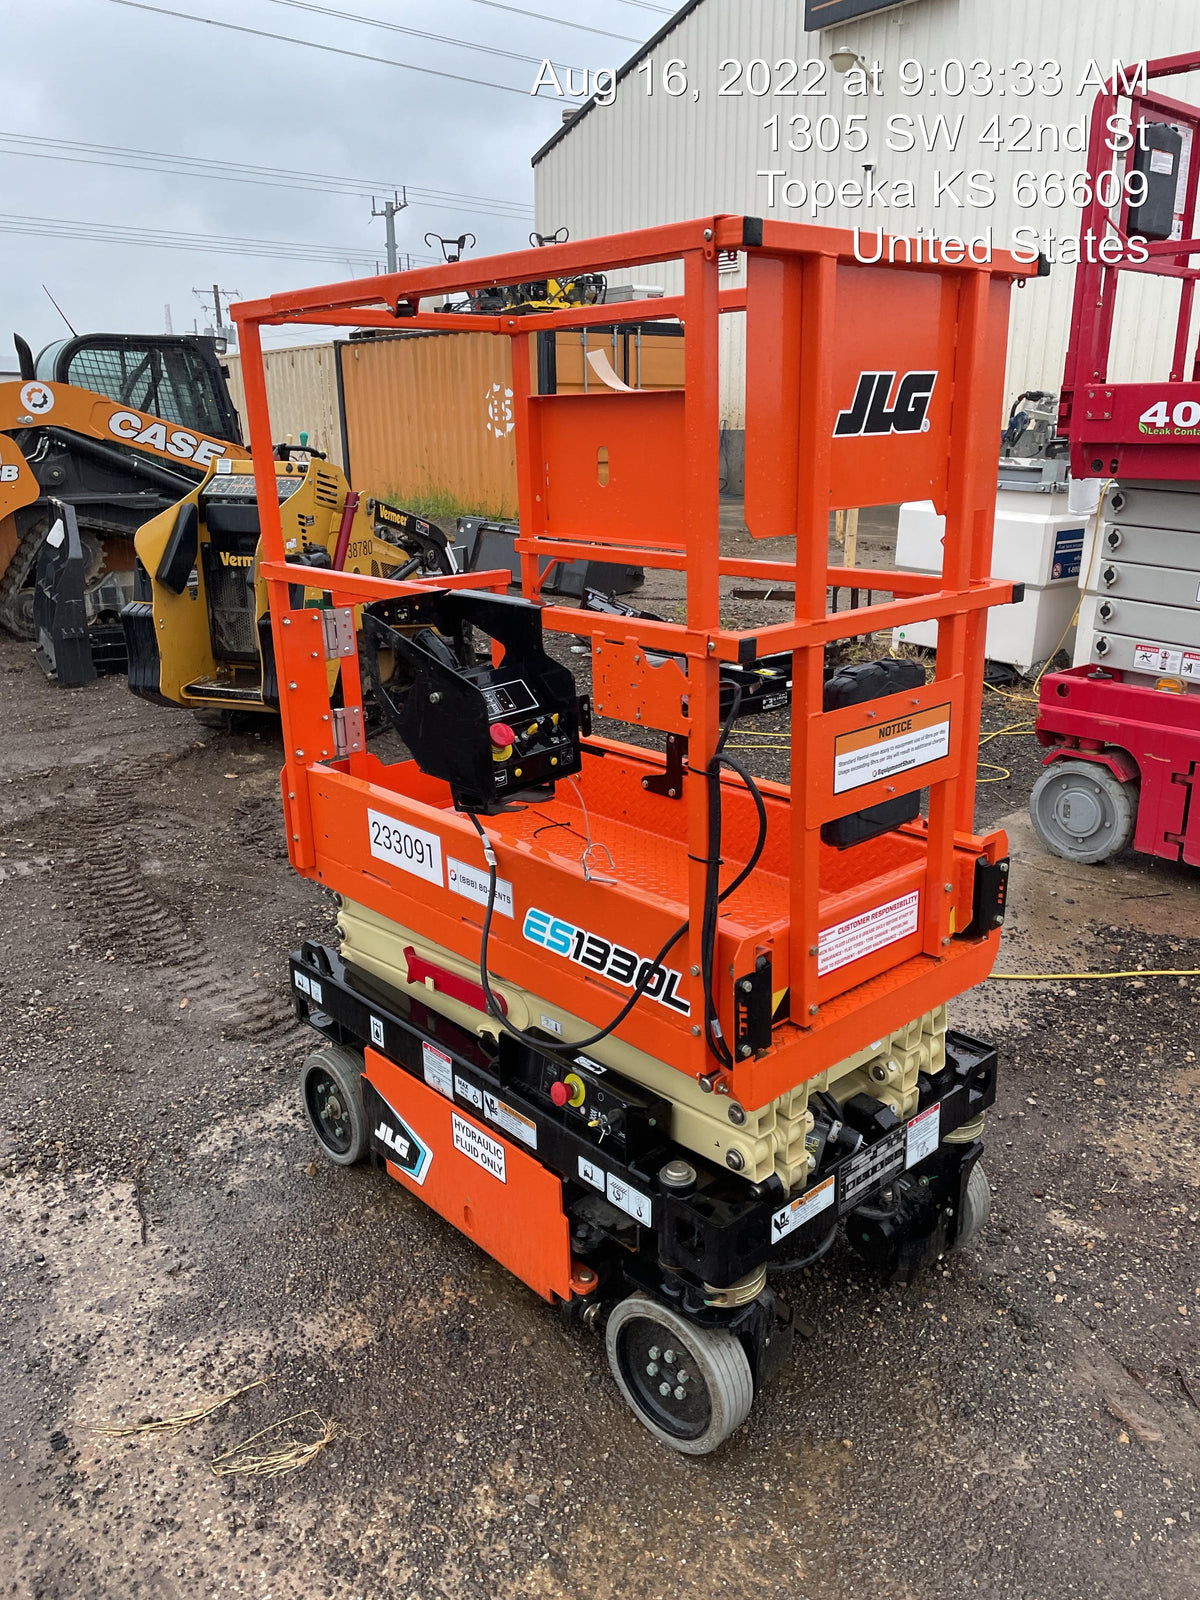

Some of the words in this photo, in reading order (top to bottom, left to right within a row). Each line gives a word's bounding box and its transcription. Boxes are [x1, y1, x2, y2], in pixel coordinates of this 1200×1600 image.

[833, 372, 937, 437] JLG
[108, 411, 227, 466] CASE
[1148, 427, 1171, 435] Leak
[380, 504, 408, 527] Vermeer
[220, 552, 254, 567] Verm
[879, 719, 912, 739] NOTICE
[877, 758, 916, 776] EquipmentShare
[372, 821, 433, 869] 233091
[459, 874, 477, 890] (888)
[837, 915, 871, 935] CUSTOMER
[871, 894, 918, 920] RESPONSIBILITY
[523, 908, 691, 1015] ES1330L
[374, 1121, 410, 1160] JLG
[454, 1118, 503, 1161] HYDRAULIC
[455, 1134, 479, 1159] FLUID
[480, 1152, 503, 1175] ONLY
